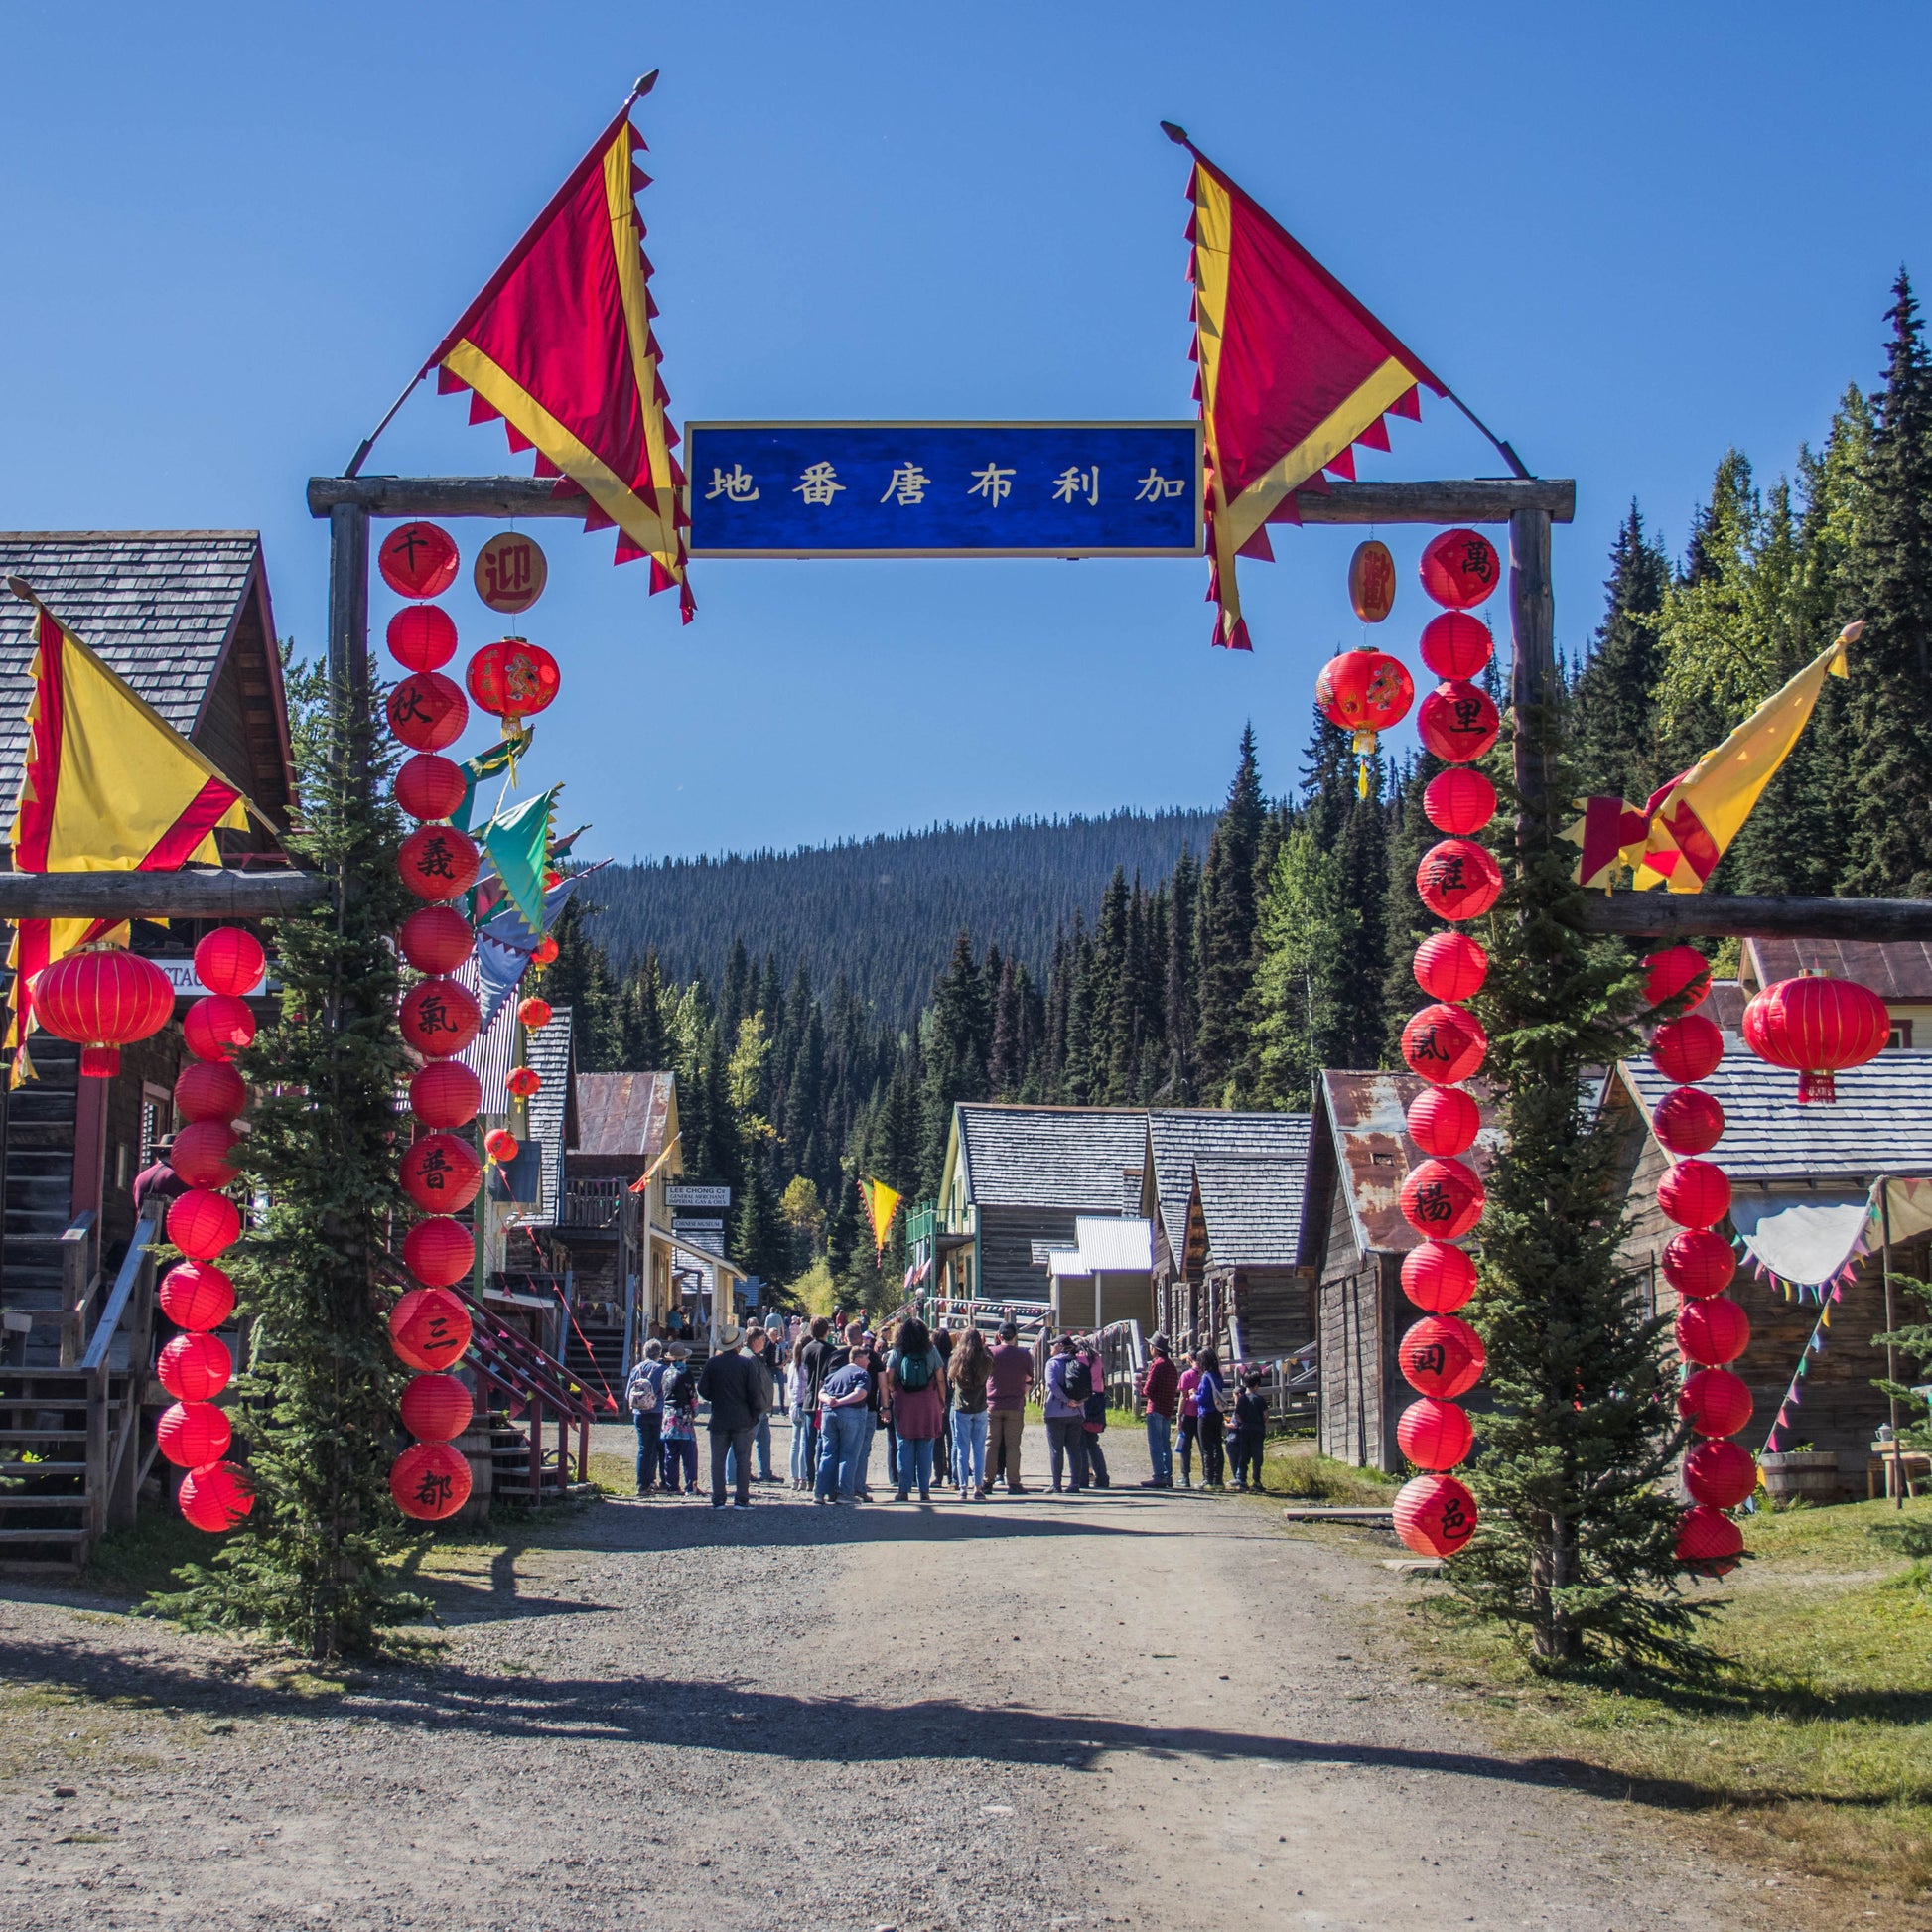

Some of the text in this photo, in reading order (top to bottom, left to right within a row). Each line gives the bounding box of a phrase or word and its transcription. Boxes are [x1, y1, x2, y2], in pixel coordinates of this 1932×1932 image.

[392, 529, 428, 573] 千
[1461, 540, 1492, 584] 萬
[484, 543, 533, 604] 迎
[391, 687, 433, 727] 秋
[1449, 698, 1487, 735] 里
[417, 838, 456, 880] 義
[417, 996, 458, 1035] 氣
[416, 1148, 454, 1190] 普
[423, 1317, 457, 1350] 三
[413, 1470, 452, 1513] 都
[1439, 1497, 1473, 1540] 邑
